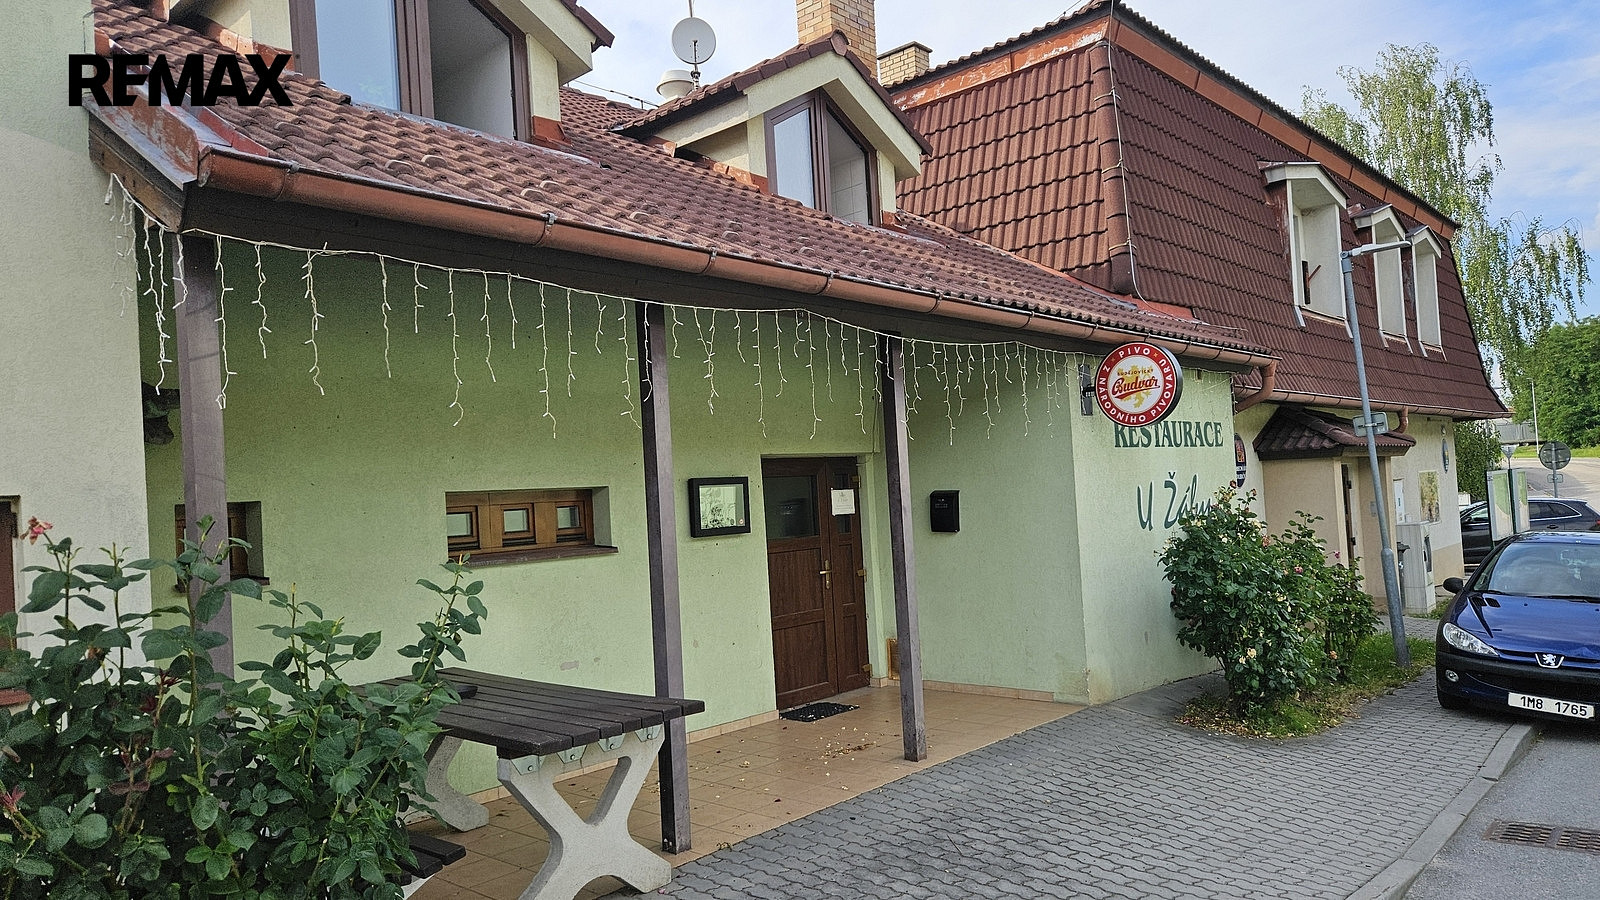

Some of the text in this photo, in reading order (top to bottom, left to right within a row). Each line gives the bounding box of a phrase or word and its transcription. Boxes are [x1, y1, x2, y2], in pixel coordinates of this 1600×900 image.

[1118, 346, 1151, 358] PIVO
[1099, 358, 1173, 423] Z NÁRODNÍHO PIVOVARU
[1111, 375, 1159, 396] Budvar
[1113, 420, 1224, 448] RESTAURACE
[1137, 481, 1153, 531] U
[1520, 695, 1587, 716] 1M8 1765
